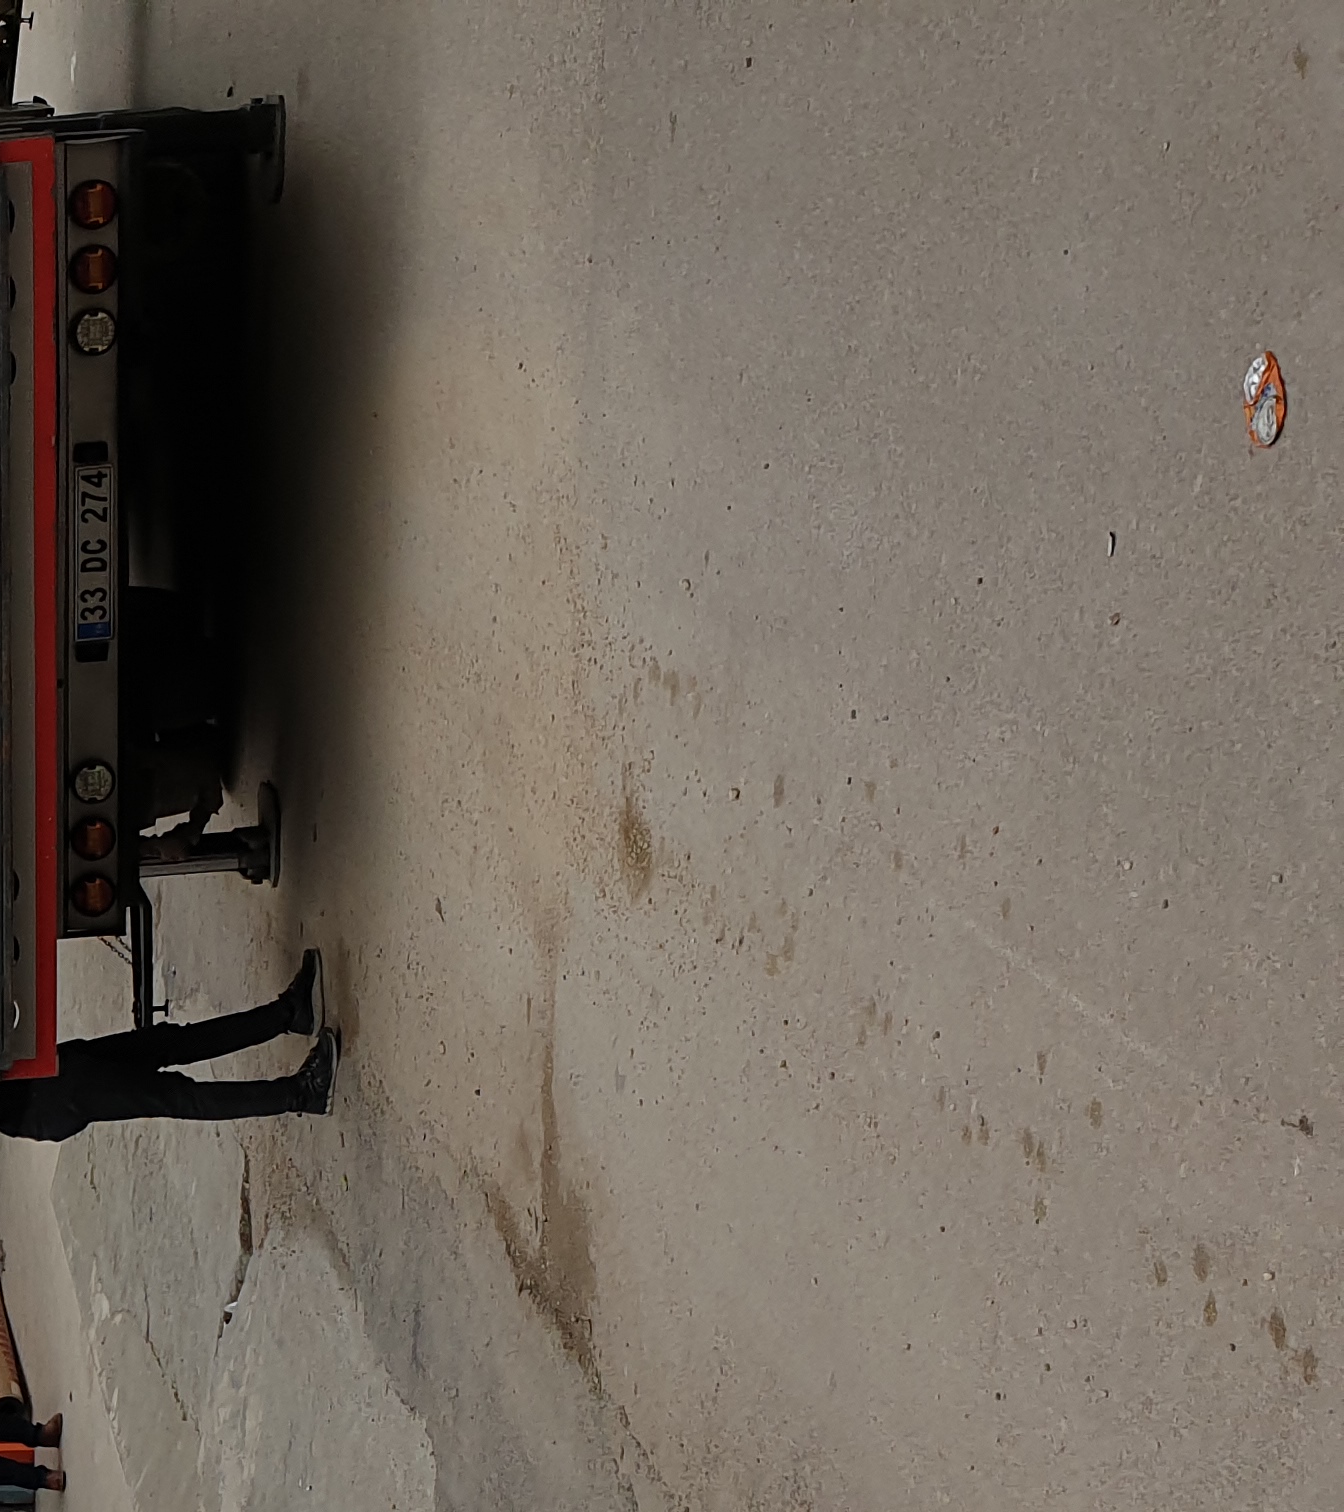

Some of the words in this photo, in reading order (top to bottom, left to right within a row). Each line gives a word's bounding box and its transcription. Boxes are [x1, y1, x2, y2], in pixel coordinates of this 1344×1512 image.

[79, 470, 108, 524] 274
[79, 539, 108, 573] DC
[79, 587, 108, 621] 33
